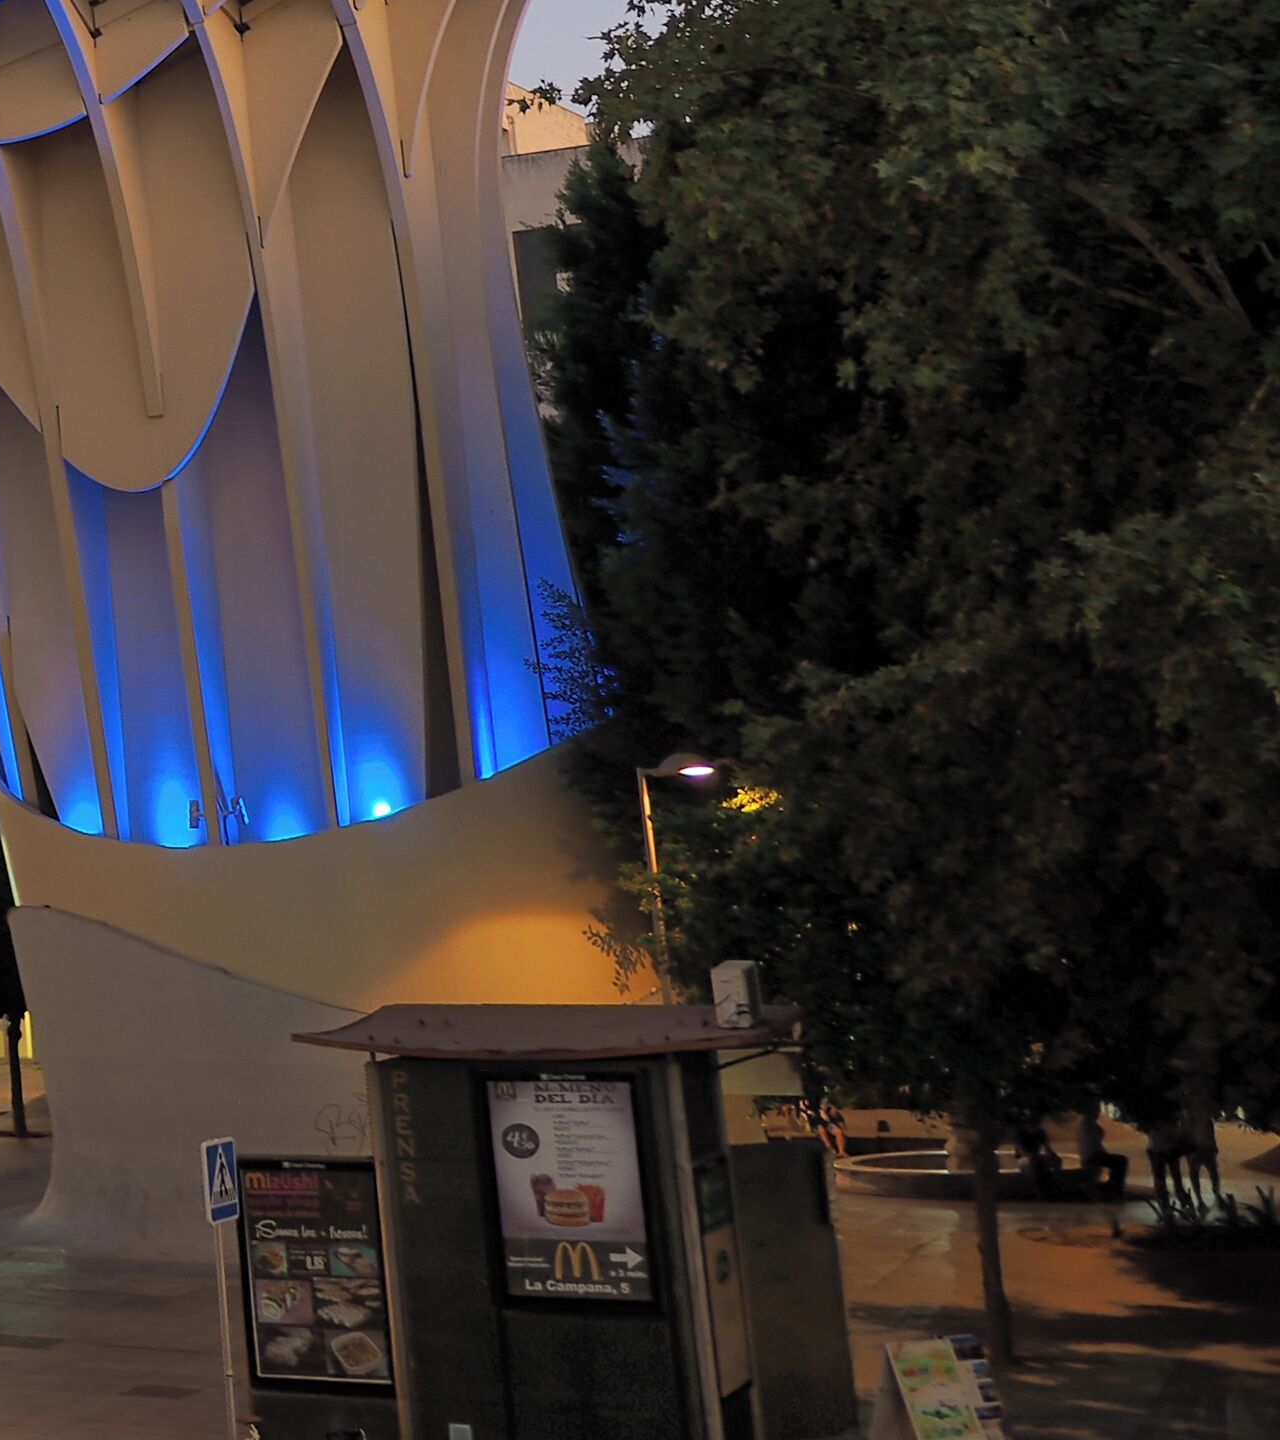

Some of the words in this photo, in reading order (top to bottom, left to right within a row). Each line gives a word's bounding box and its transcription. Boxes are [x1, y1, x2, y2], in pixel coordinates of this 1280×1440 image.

[534, 1094, 572, 1104] DEL
[391, 1070, 423, 1205] PRENSA
[525, 1279, 543, 1291] La
[546, 1280, 618, 1295] Campana,
[620, 1282, 631, 1294] 5
